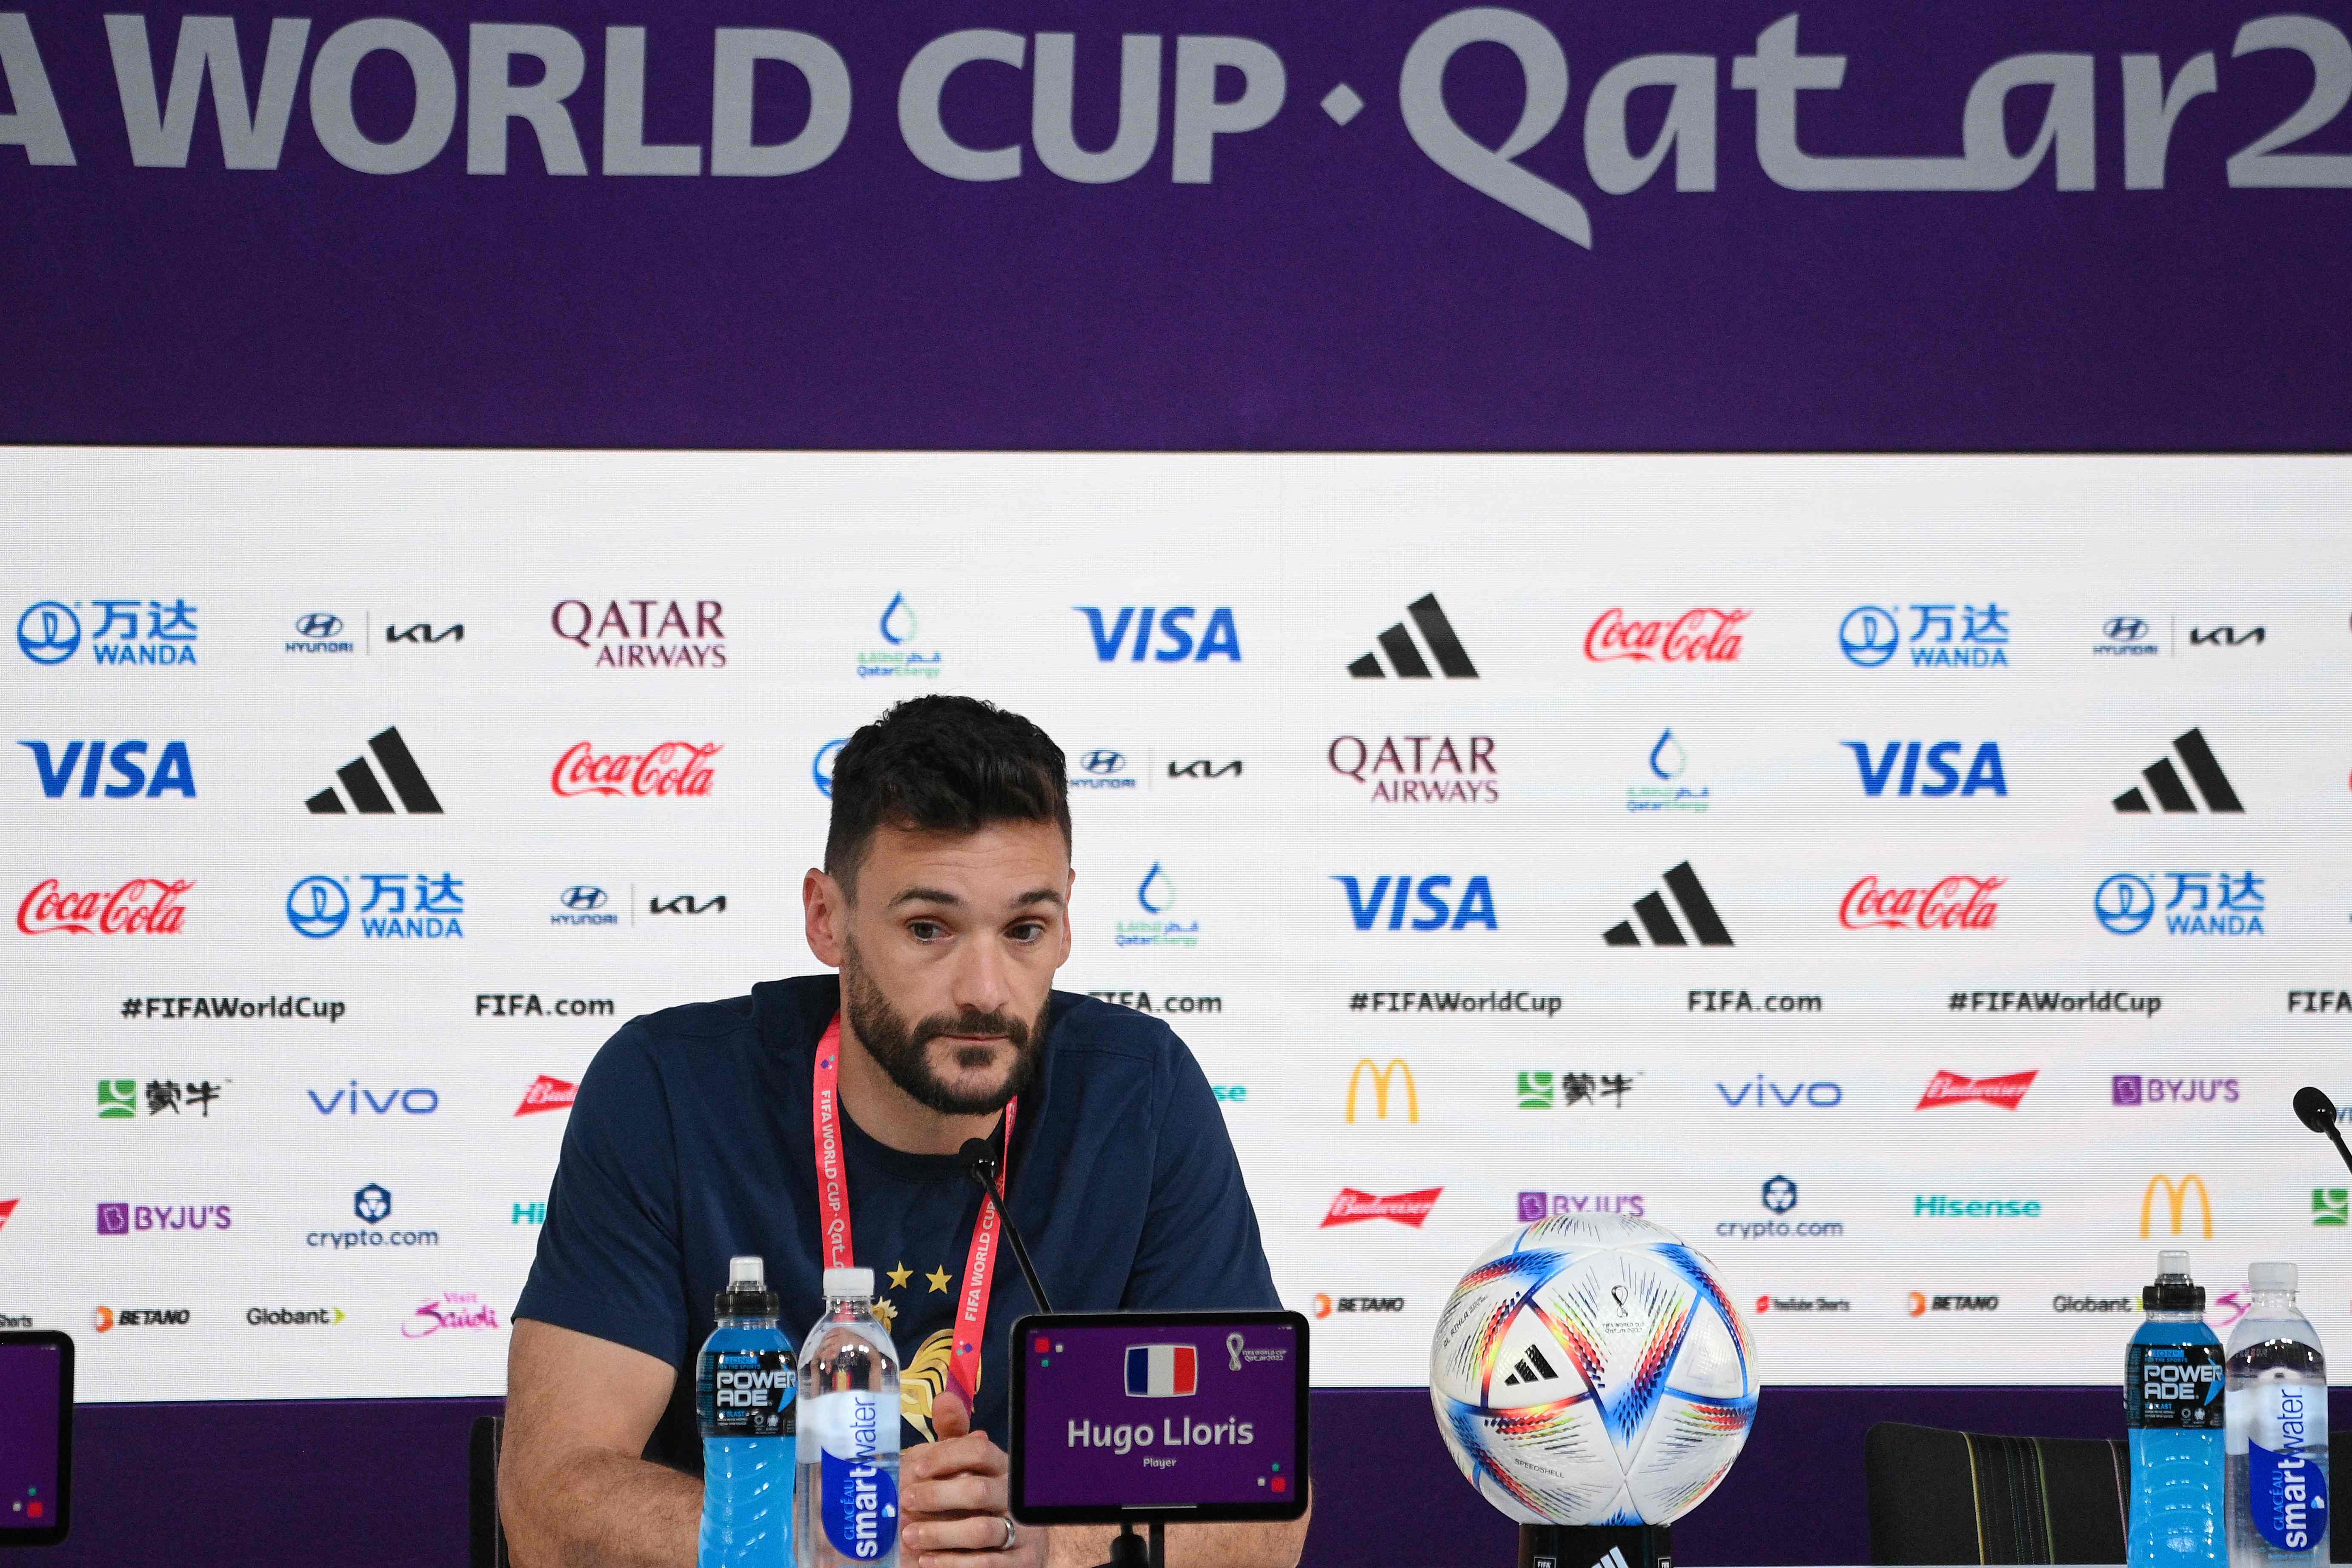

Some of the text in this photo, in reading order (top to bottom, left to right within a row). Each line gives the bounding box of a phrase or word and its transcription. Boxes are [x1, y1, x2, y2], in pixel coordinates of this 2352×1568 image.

[104, 14, 851, 176] WORLD
[898, 29, 1286, 183] CUP
[91, 598, 197, 641] 万达
[551, 599, 725, 647] QATAR
[1910, 603, 2009, 643] 万达
[286, 642, 353, 652] HYUNDAI
[1073, 606, 1242, 663] VISA
[1584, 608, 1750, 662] Coca-Cola
[93, 644, 197, 665] WANDA
[595, 644, 727, 668] AIRWAYS
[1911, 647, 2008, 667] WANDA
[2094, 645, 2158, 654] HYUNDAI
[17, 740, 197, 798] VISA
[551, 741, 722, 797] Coca-Cola
[1327, 735, 1497, 783] QATAR
[1841, 740, 2008, 797] VISA
[1372, 780, 1499, 803] AIRWAYS
[360, 872, 464, 914] 万达
[1330, 874, 1498, 932] VISA
[1839, 876, 2006, 930] Coca-Cola
[2165, 870, 2265, 912] 万达
[16, 878, 194, 935] Coca-Cola
[551, 914, 617, 924] HYUNDAI
[361, 917, 463, 938] WANDA
[2166, 915, 2264, 935] WANDA
[121, 996, 345, 1023] #FIFAWorldCup
[476, 994, 614, 1016] FIFA.com
[1349, 991, 1562, 1017] #FIFAWorldCup
[1688, 990, 1822, 1012] FIFA.com
[1949, 991, 2161, 1018] #FIFAWorldCup
[145, 1079, 220, 1117] 蒙牛
[307, 1080, 438, 1114] vivo
[1562, 1072, 1632, 1107] 蒙牛
[1716, 1074, 1842, 1107] vivo
[1925, 1077, 2029, 1099] Budweiser
[2148, 1079, 2239, 1102] BYJU'S
[821, 1090, 832, 1123] FIFA
[821, 1124, 837, 1180] WORLD
[827, 1181, 841, 1212] CUP
[1328, 1191, 1434, 1215] Budweiser
[1914, 1195, 2041, 1217] Hisense
[134, 1205, 231, 1230] BYJU'S
[1717, 1220, 1842, 1238] crypto.com
[307, 1229, 438, 1249] crypto.com
[970, 1232, 990, 1288] WORLD
[119, 1309, 190, 1325] BETANO
[247, 1308, 329, 1325] Globant
[964, 1288, 981, 1322] FIFA
[1338, 1298, 1404, 1312] BETANO
[1932, 1296, 1998, 1310] BETANO
[2054, 1296, 2131, 1311] Globant
[400, 1299, 500, 1339] Saudi
[717, 1371, 797, 1389] POWER
[2144, 1365, 2223, 1382] POWER
[1067, 1415, 1254, 1456] Hugo Lloris
[850, 1397, 878, 1557] smartwater
[1143, 1458, 1177, 1470] Player
[1514, 1458, 1565, 1479] SPEEDSHELL
[2277, 1389, 2308, 1548] smartwater
[841, 1480, 855, 1540] GLACÉAU
[2269, 1471, 2284, 1531] GLACÉAU
